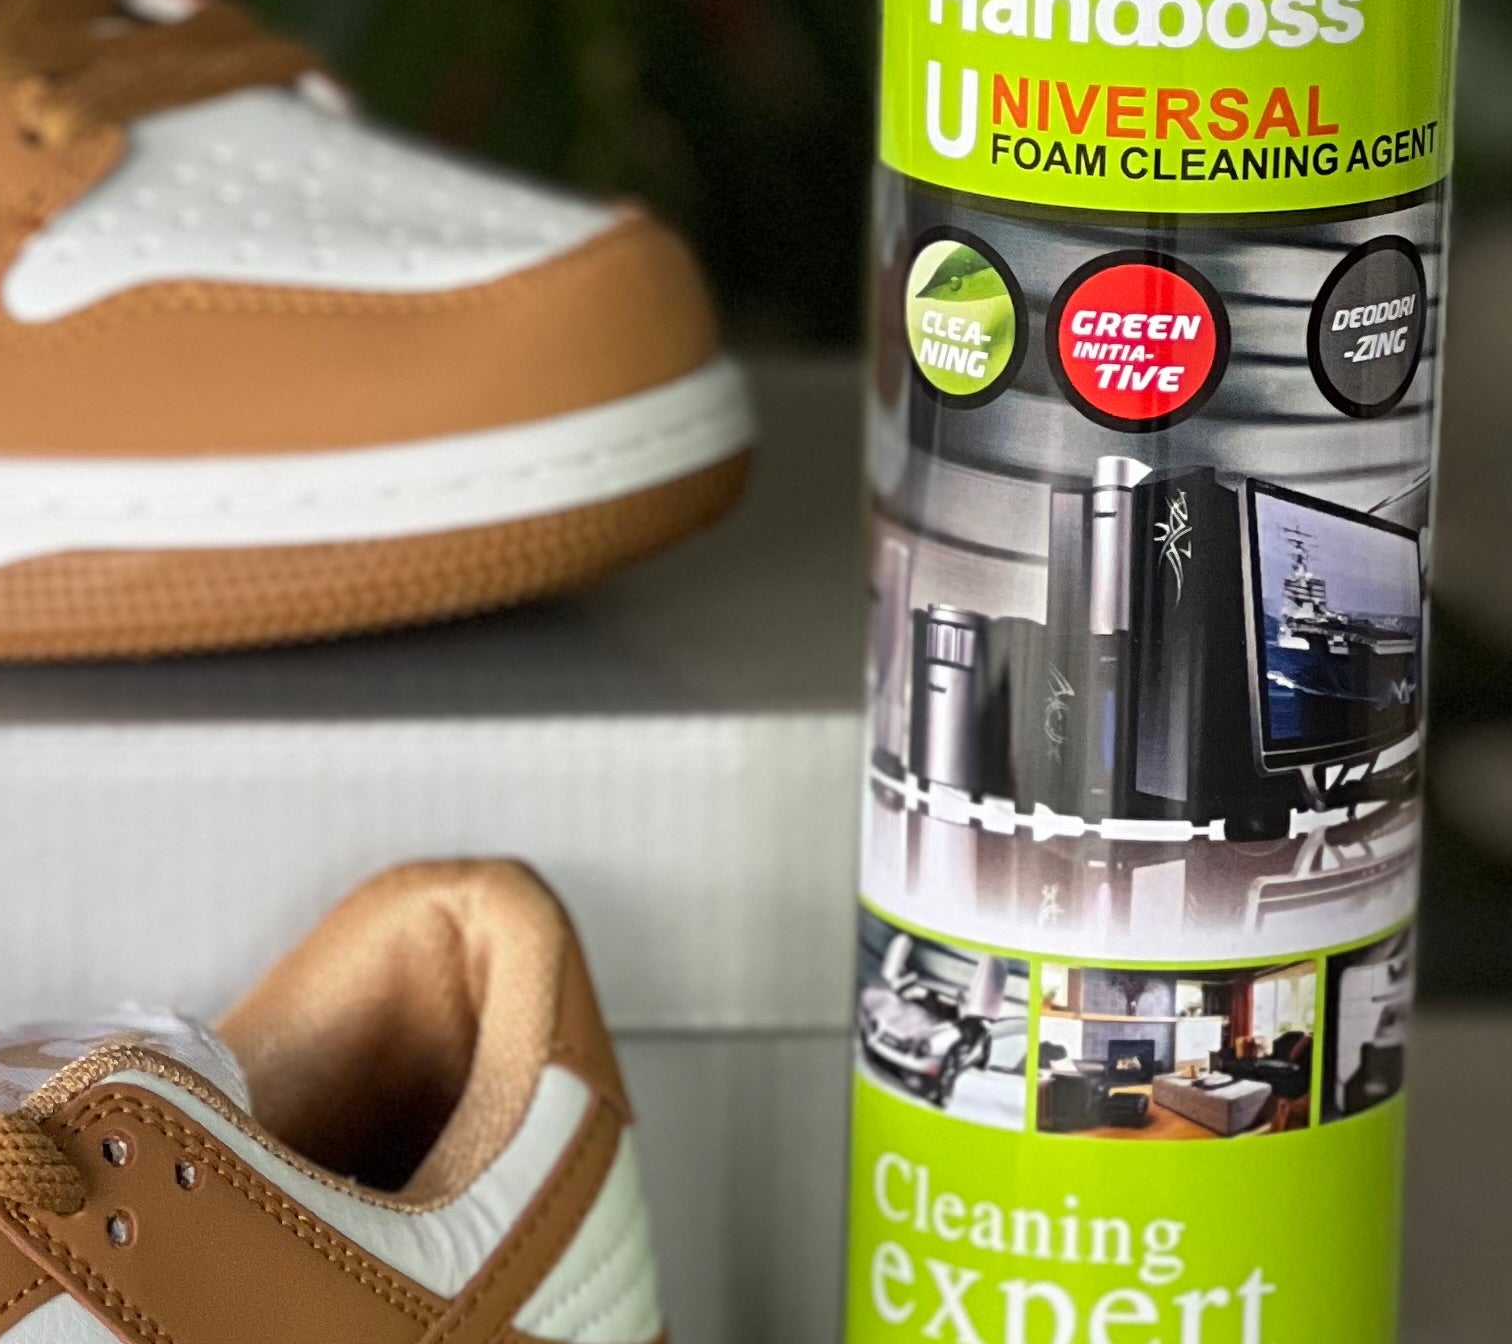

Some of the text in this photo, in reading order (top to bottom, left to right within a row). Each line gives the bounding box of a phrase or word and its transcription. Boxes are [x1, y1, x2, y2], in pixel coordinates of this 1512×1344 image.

[990, 120, 1439, 181] FOAM CLEANING AGENT
[921, 309, 992, 346] CLEA-
[1070, 309, 1202, 341] GREEN
[1331, 293, 1416, 332] DEODORI
[919, 337, 989, 379] NING
[1072, 340, 1155, 362] INITIA-
[1094, 363, 1185, 393] TIVE
[873, 1151, 1186, 1286] Cleaning
